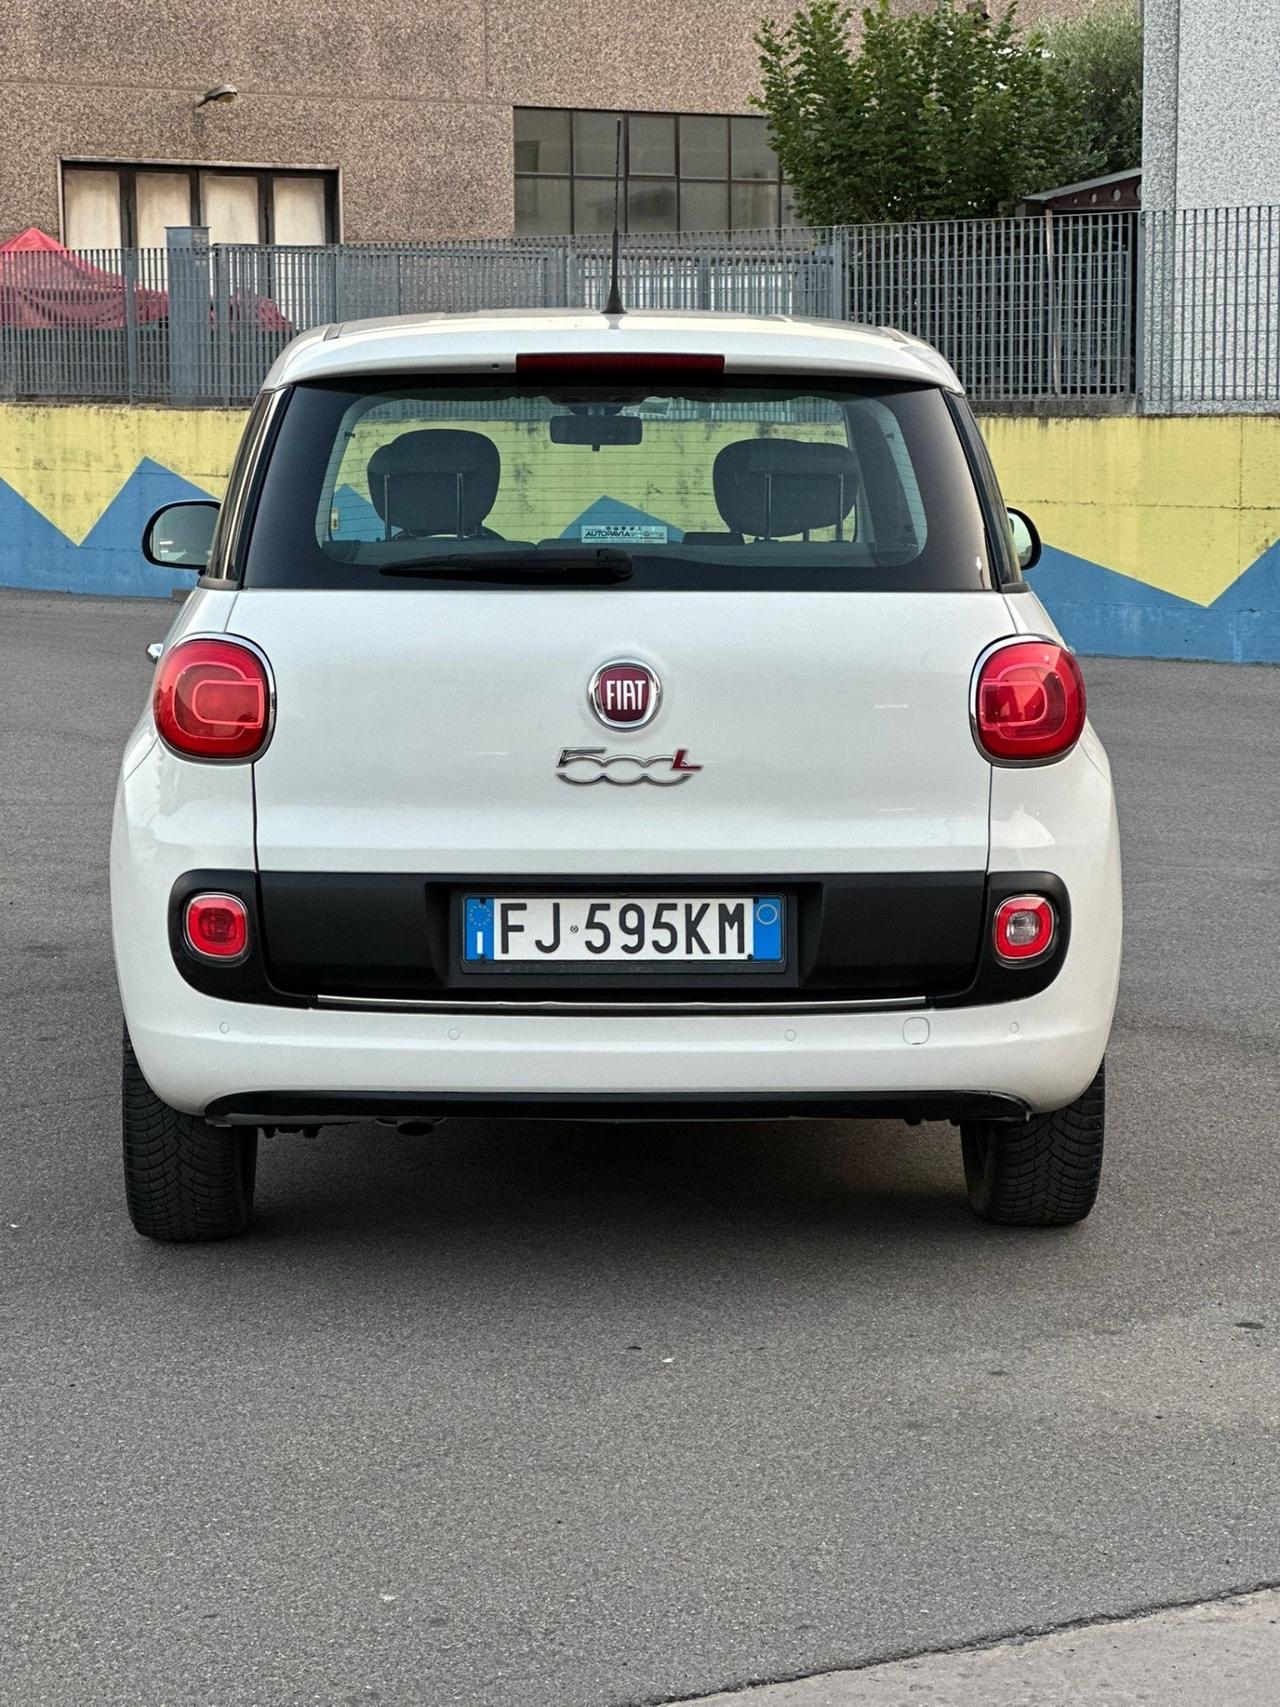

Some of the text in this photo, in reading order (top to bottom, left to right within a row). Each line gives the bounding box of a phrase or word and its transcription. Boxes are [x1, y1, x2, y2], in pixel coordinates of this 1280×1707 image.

[606, 680, 646, 711] FIAT
[555, 747, 703, 787] 500L
[476, 931, 483, 954] I
